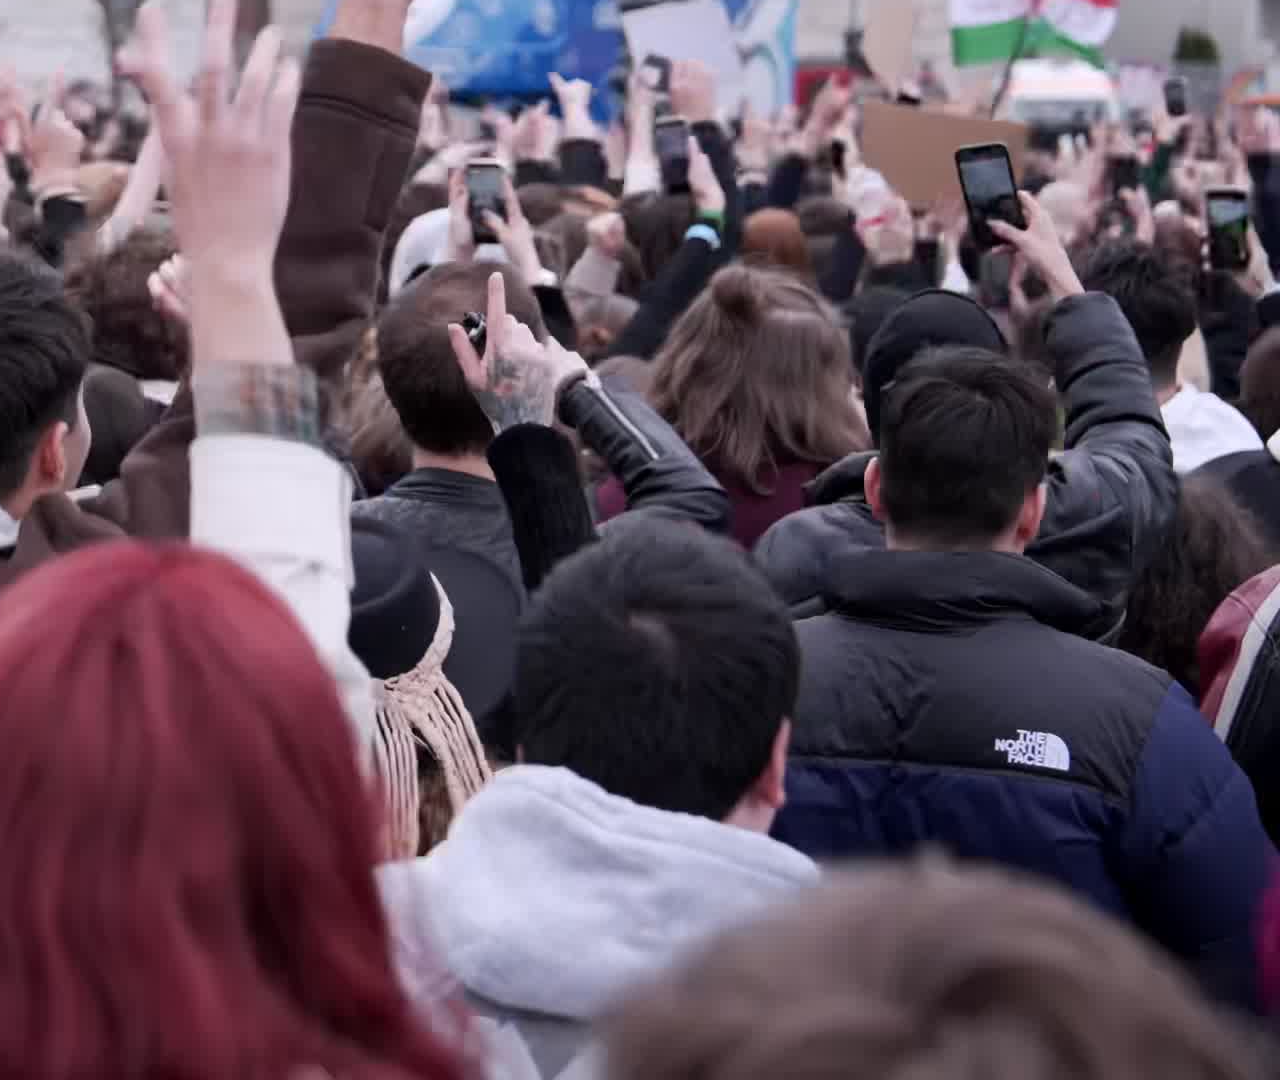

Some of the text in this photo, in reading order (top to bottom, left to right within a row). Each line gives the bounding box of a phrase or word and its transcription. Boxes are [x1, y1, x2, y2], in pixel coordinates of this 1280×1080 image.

[1016, 728, 1046, 744] THE
[994, 739, 1045, 756] NORTH
[1007, 750, 1045, 766] FACE
